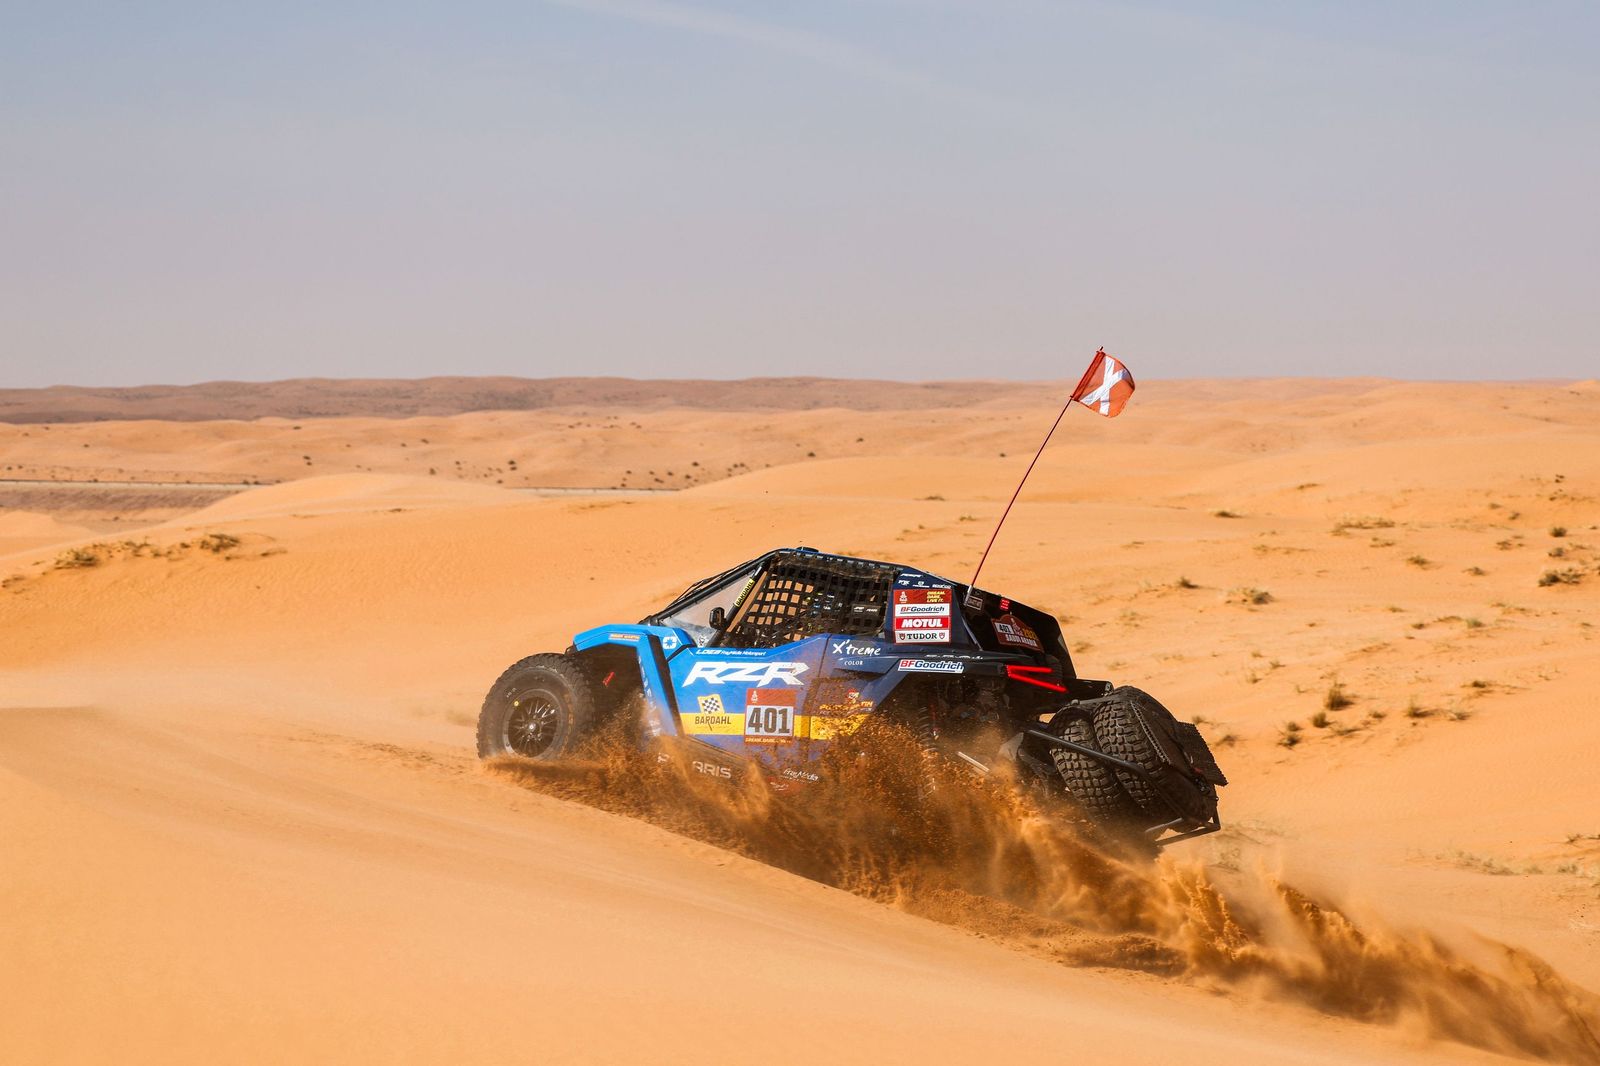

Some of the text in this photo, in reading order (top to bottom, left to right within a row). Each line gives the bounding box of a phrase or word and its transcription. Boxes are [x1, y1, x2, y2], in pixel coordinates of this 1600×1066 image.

[736, 581, 754, 606] BARDAHL
[901, 618, 943, 628] MOTUL
[900, 660, 963, 670] BFGoodrich
[682, 662, 810, 688] RZR
[694, 716, 732, 725] BARDAHL
[748, 707, 790, 734] 401
